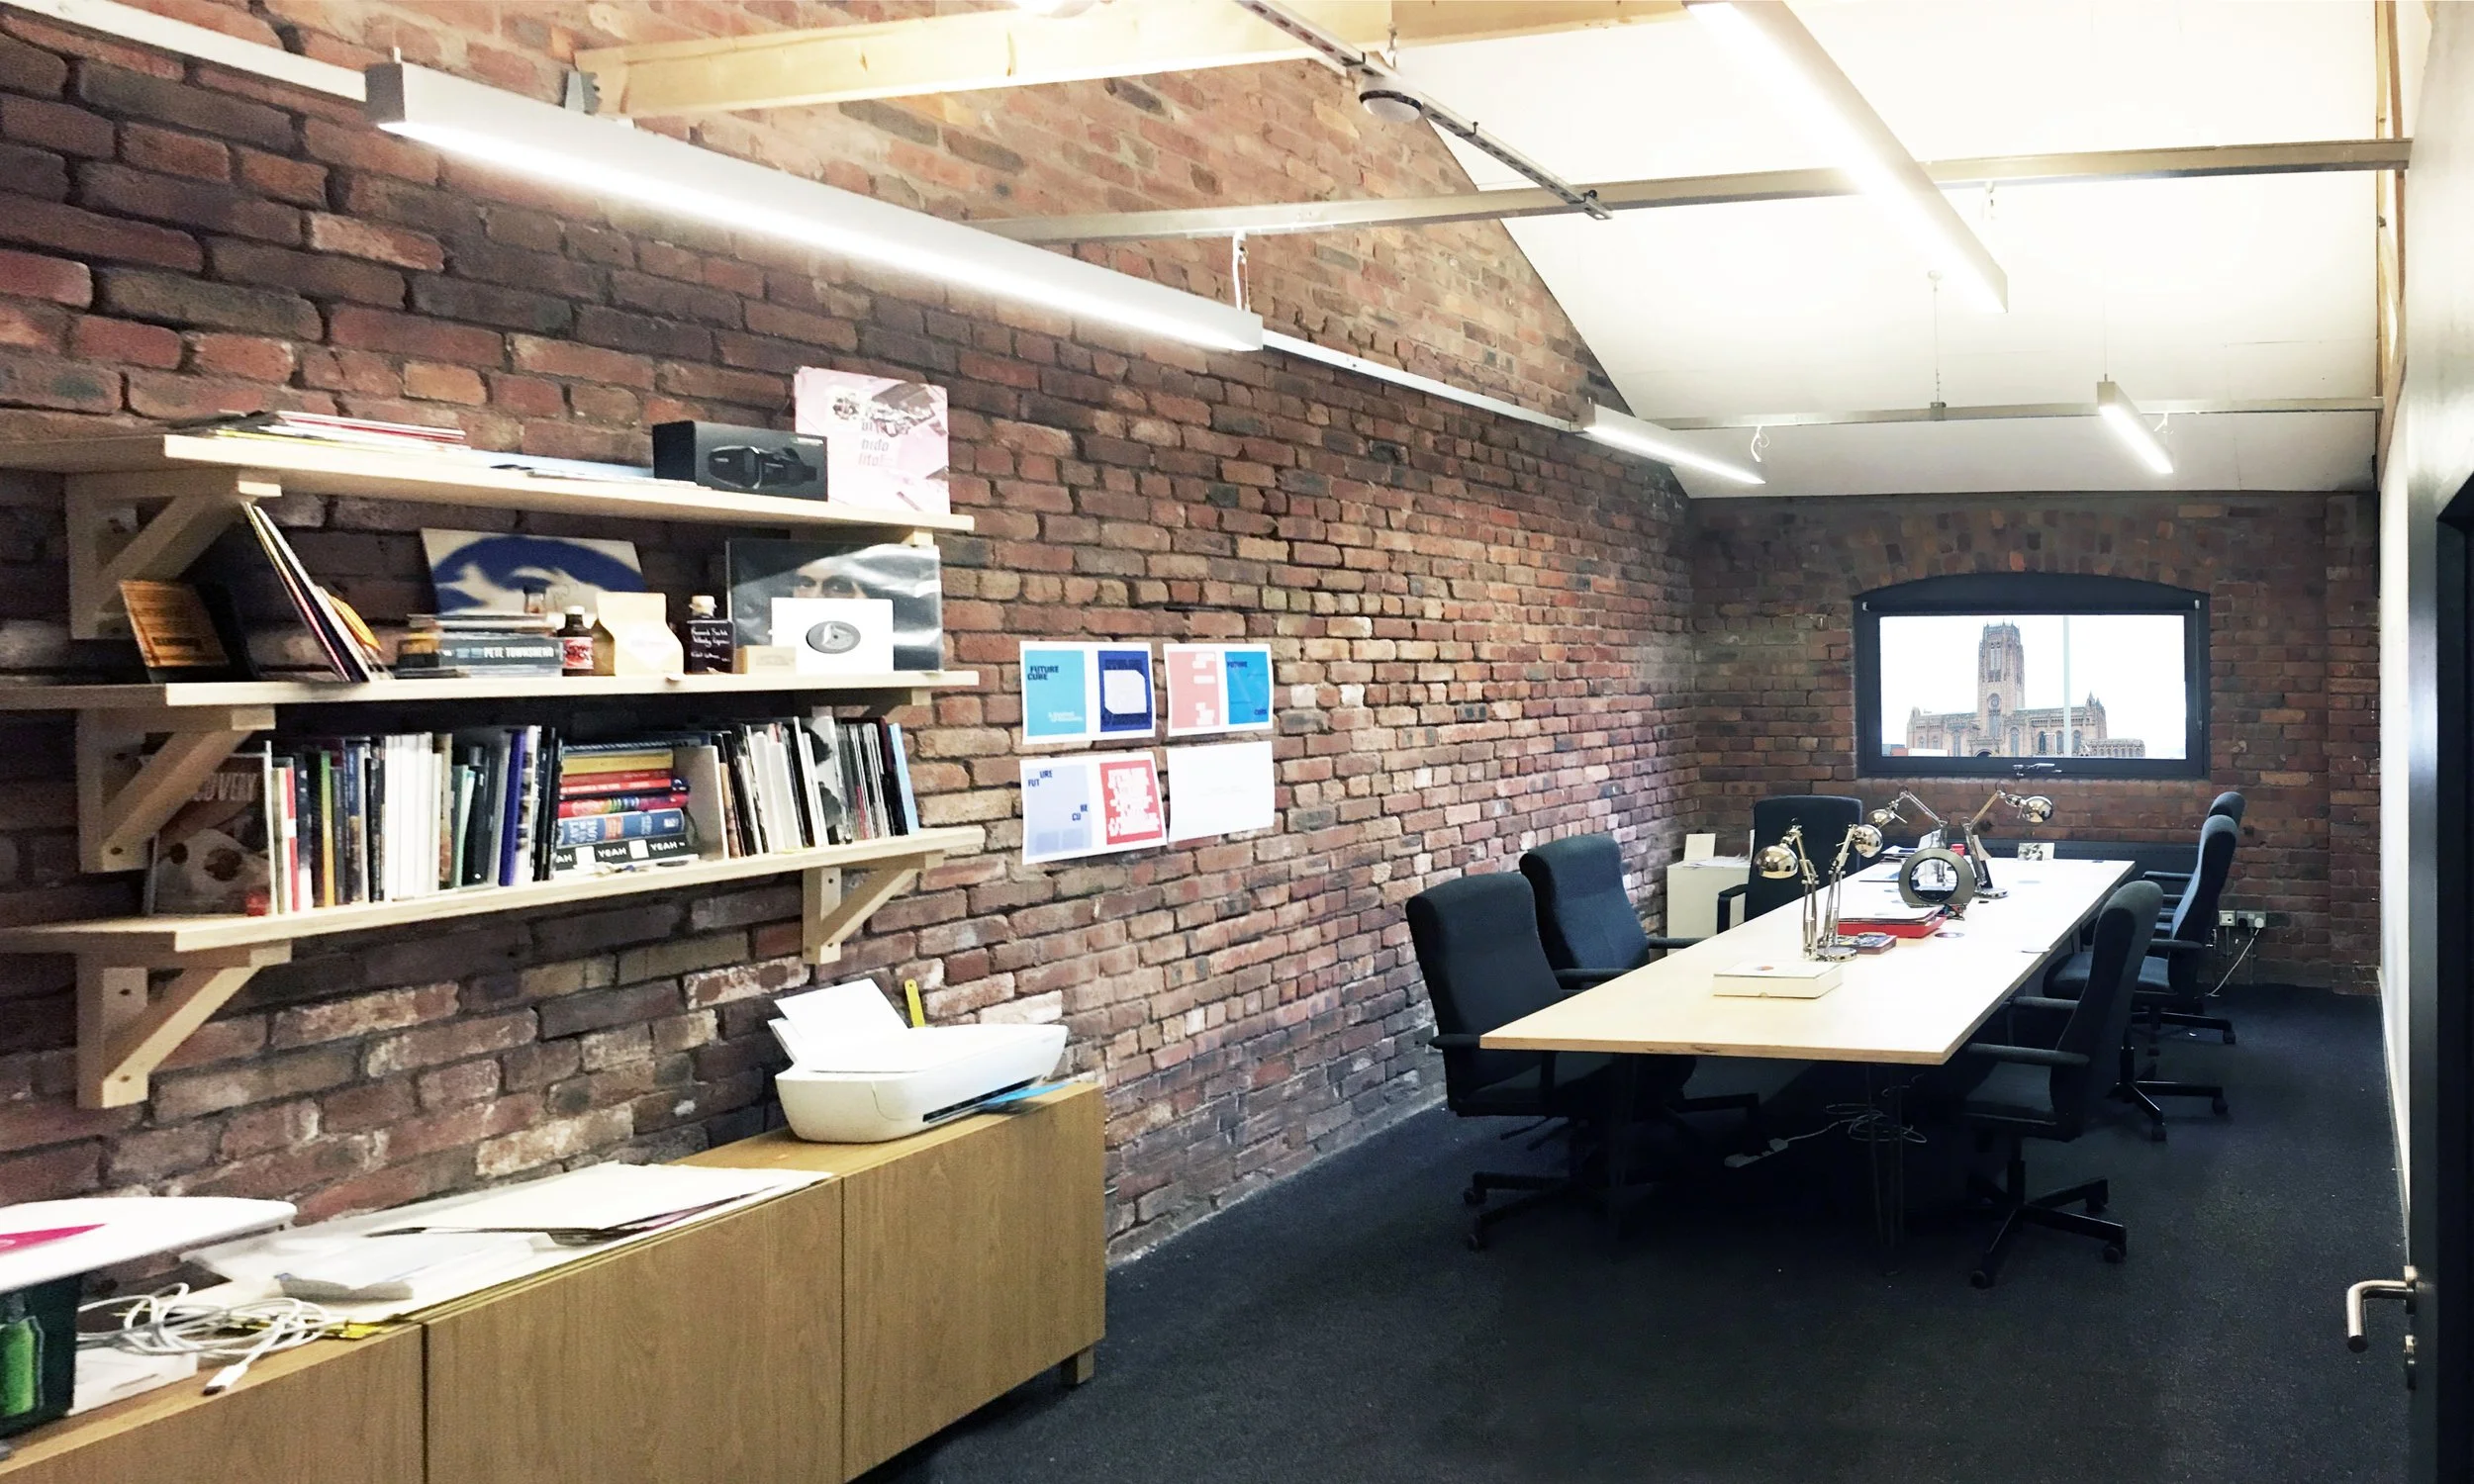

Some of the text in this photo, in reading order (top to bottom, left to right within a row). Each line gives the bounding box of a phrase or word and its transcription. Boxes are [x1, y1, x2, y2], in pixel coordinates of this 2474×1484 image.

[484, 647, 504, 658] PETE
[192, 773, 258, 801] OVERY
[597, 847, 627, 858] YEAH
[649, 841, 678, 851] YEAH
